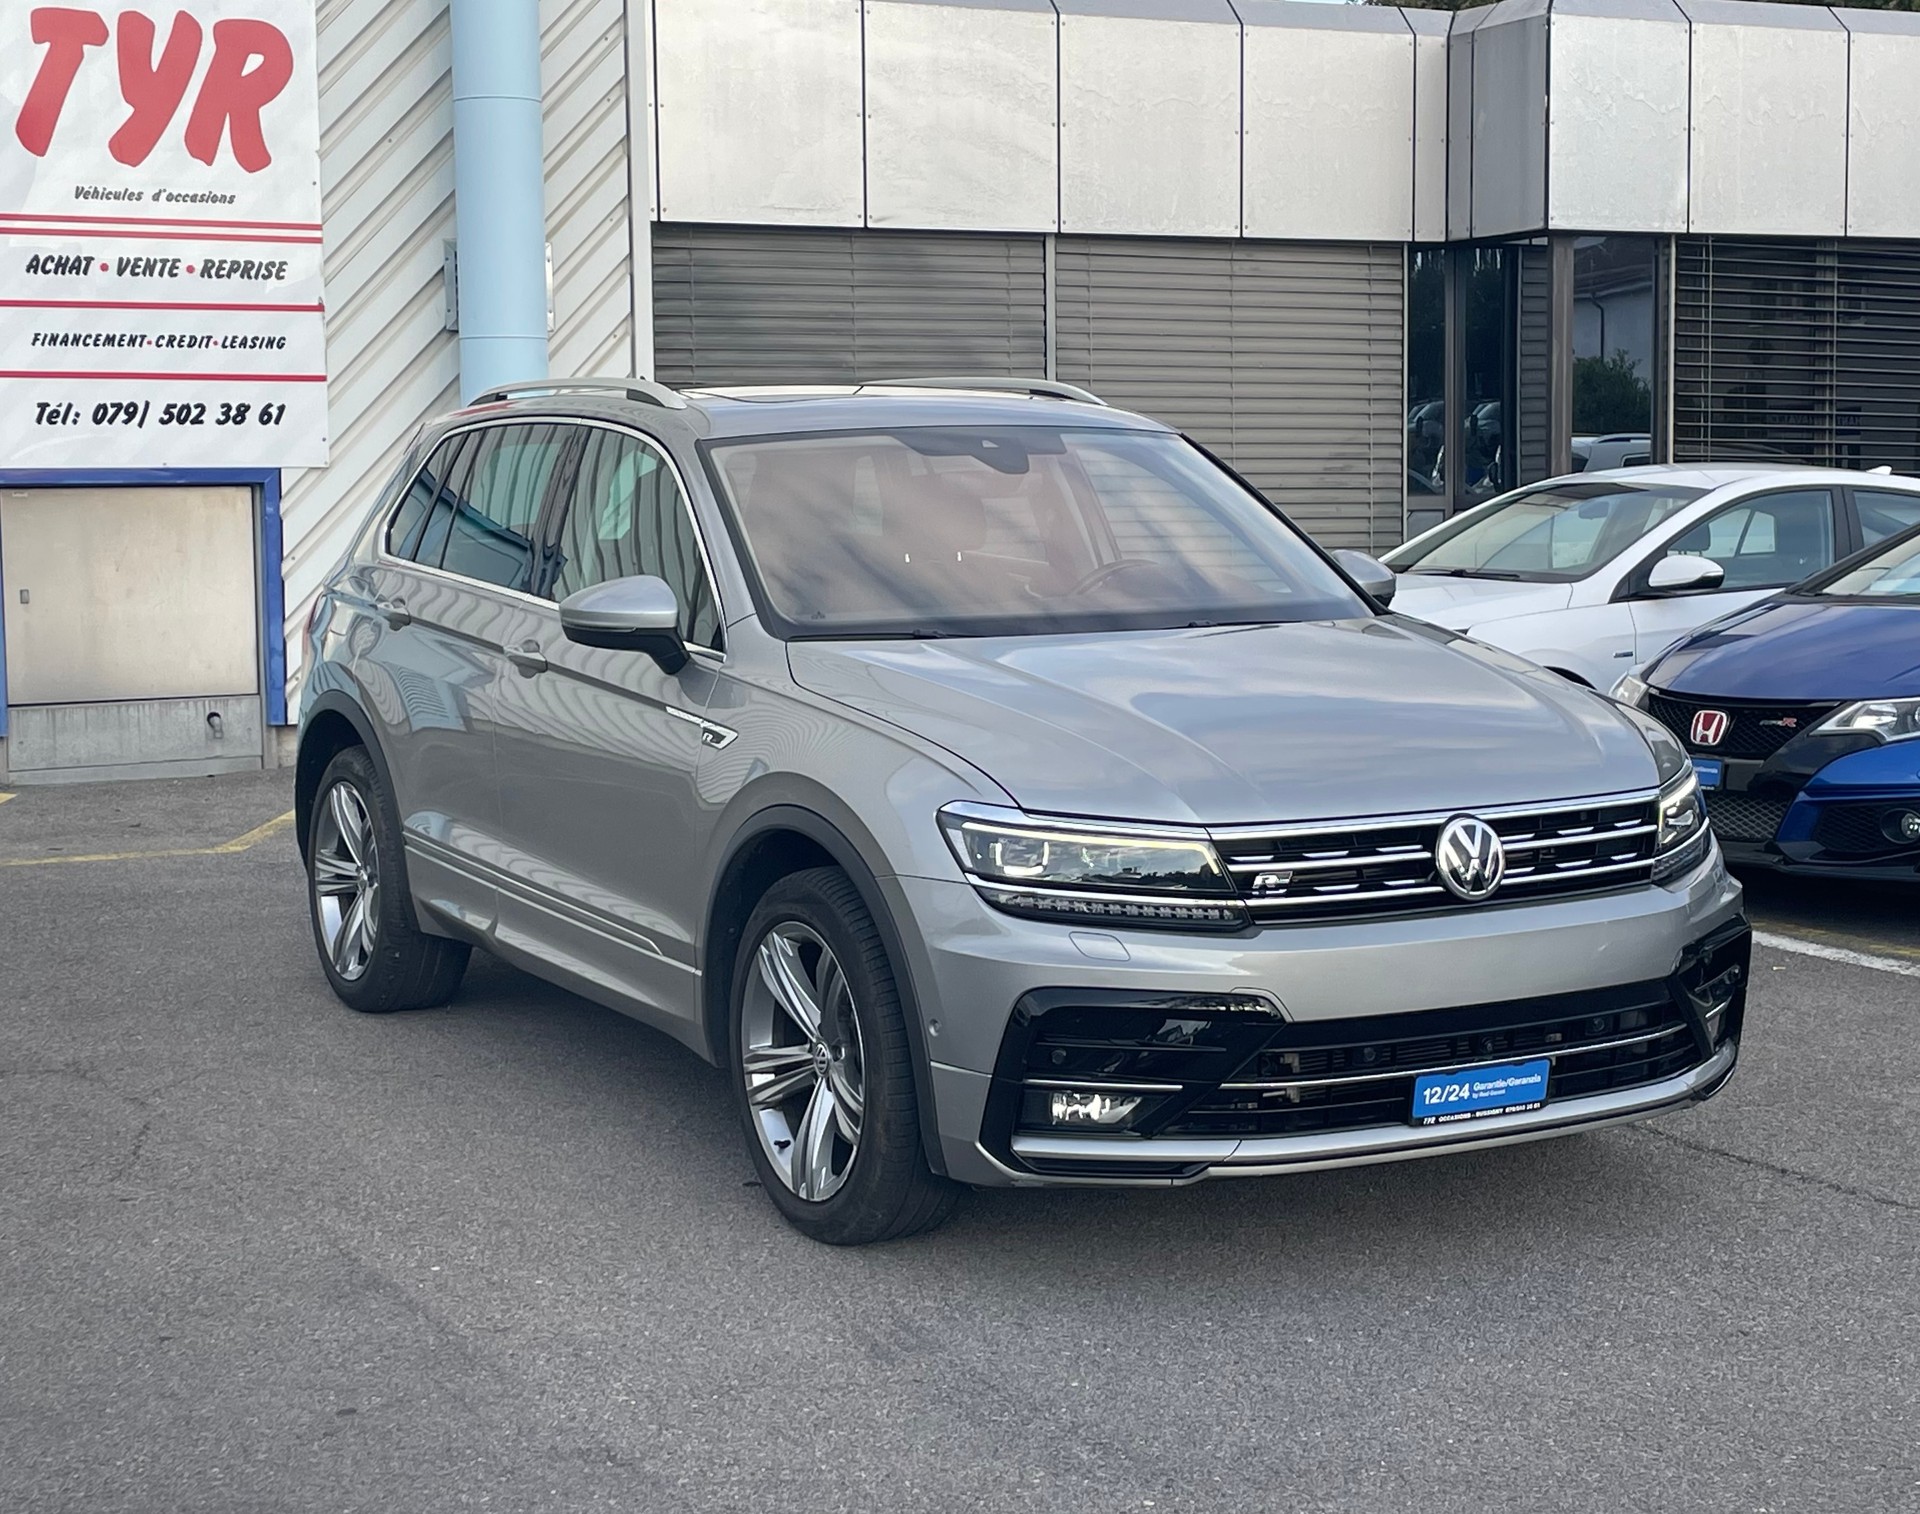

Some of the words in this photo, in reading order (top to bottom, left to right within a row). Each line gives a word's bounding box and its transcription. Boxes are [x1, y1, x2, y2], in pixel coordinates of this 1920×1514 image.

[15, 7, 294, 173] TYR
[74, 185, 143, 202] Véhicules
[151, 187, 236, 205] d'occasions
[25, 254, 95, 277] ACHAT
[116, 256, 182, 278] VENTE
[199, 258, 289, 281] REPRISE
[31, 332, 147, 348] FINANCEMENT
[155, 334, 213, 349] CREDIT
[221, 335, 287, 350] LEASING
[35, 401, 81, 426] Tél:
[158, 402, 207, 426] 502
[215, 402, 252, 426] 38
[258, 402, 287, 426] 61
[1423, 1083, 1470, 1105] 12/24
